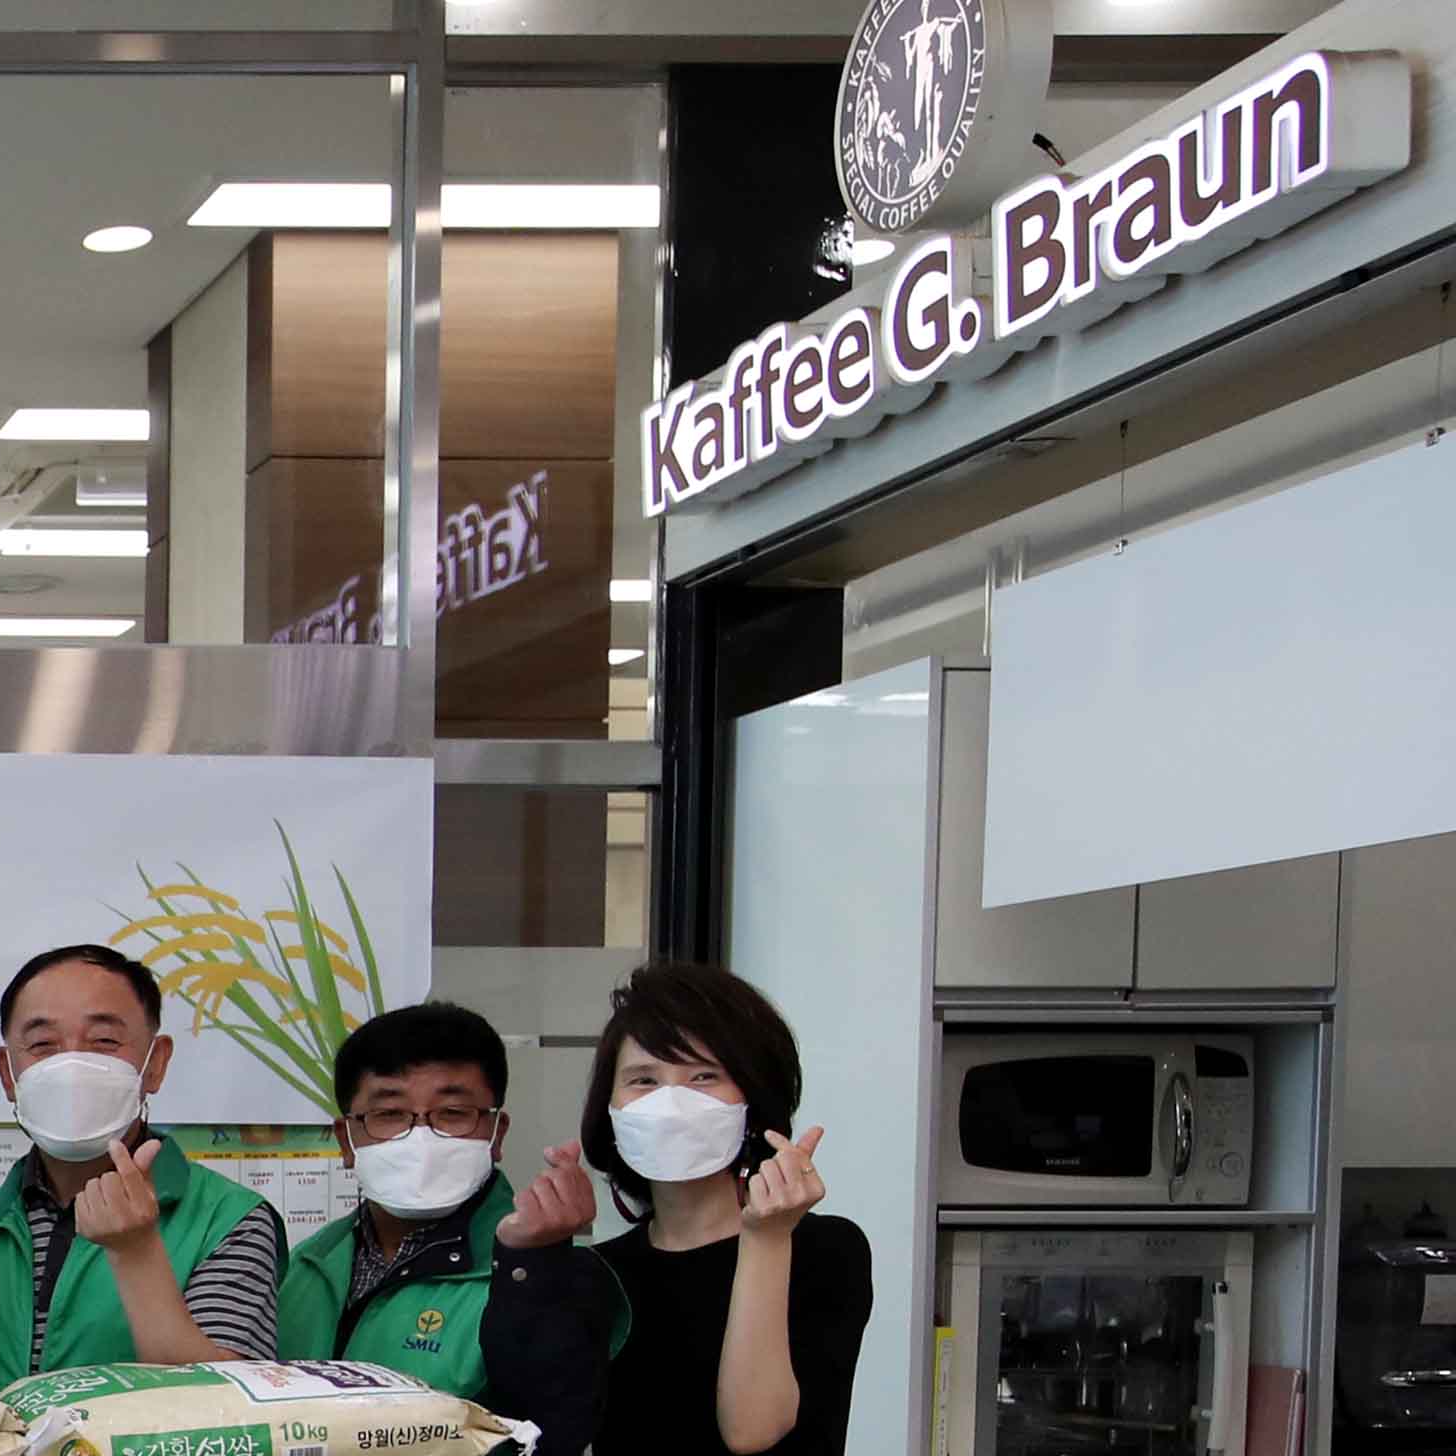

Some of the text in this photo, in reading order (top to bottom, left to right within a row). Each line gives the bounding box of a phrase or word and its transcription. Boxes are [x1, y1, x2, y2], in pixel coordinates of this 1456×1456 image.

[842, 48, 985, 229] SPECIAL COFFEE QUALITY
[650, 67, 1324, 508] Kaffee G. Braun
[278, 1421, 328, 1443] 10kg
